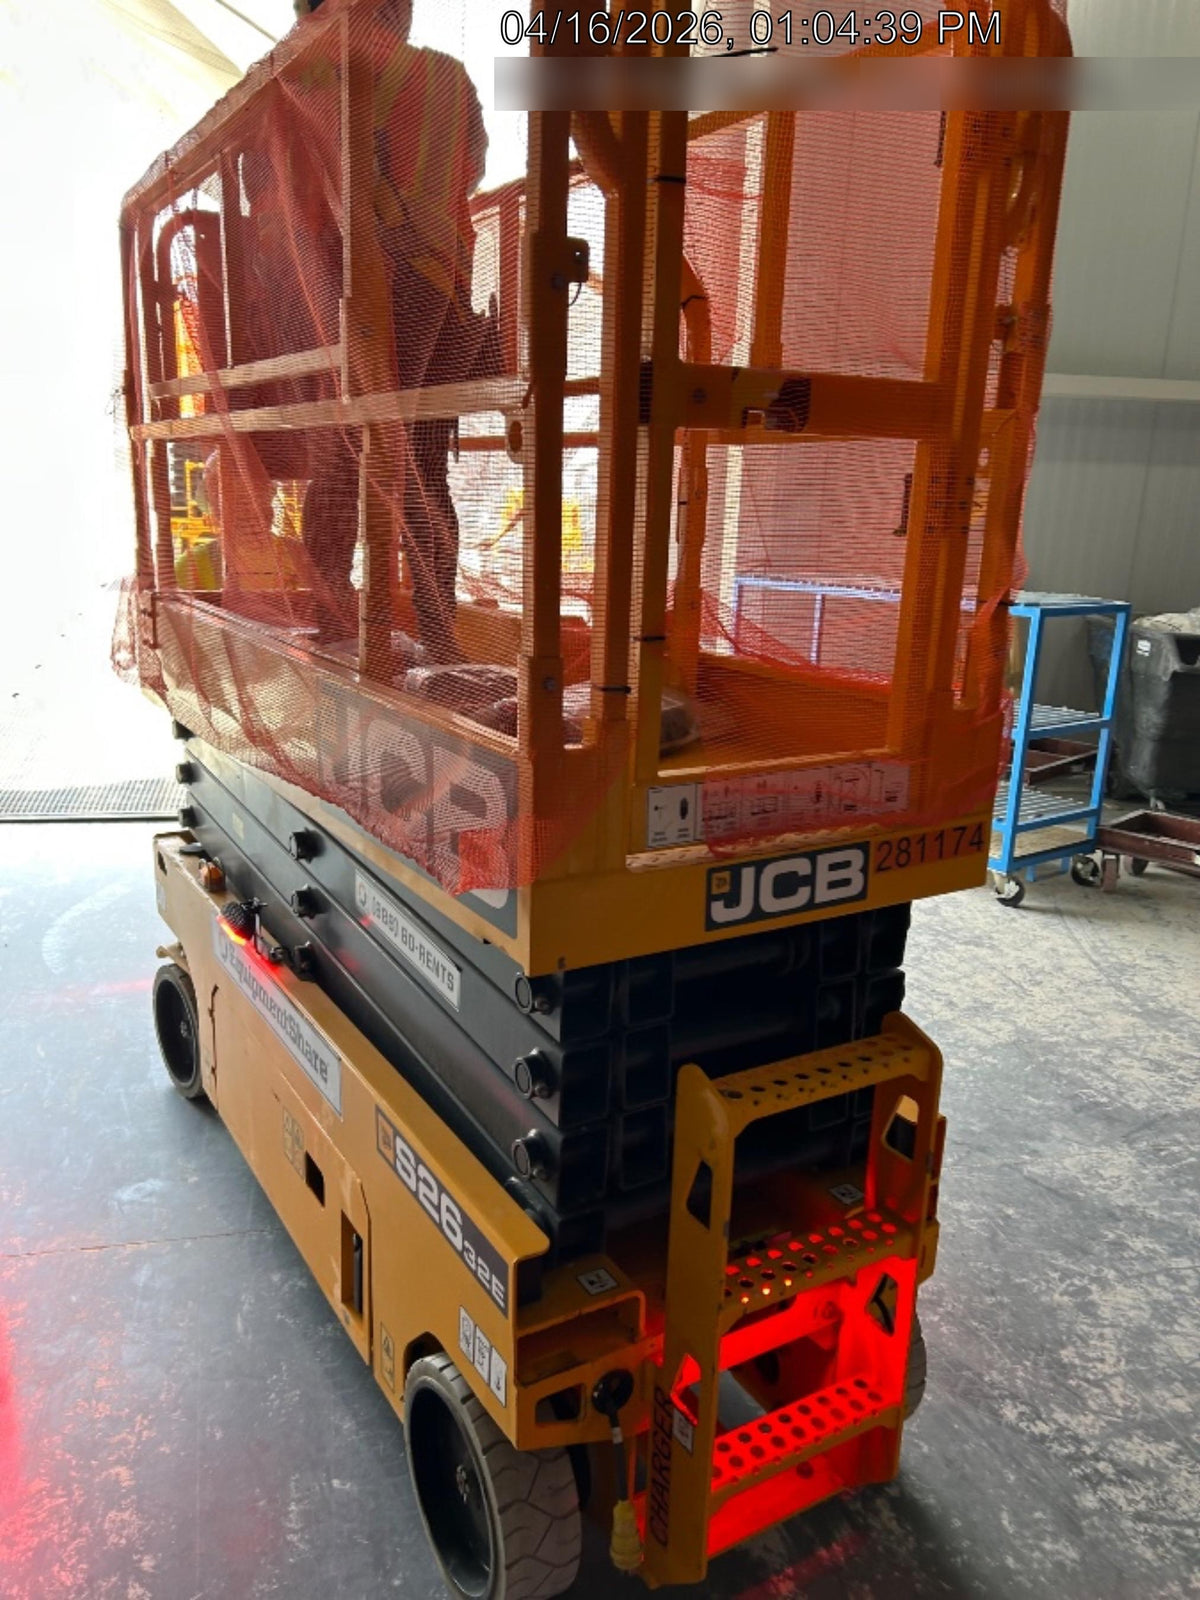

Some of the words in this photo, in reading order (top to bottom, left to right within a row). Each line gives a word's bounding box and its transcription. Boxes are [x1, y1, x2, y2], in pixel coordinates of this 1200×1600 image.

[875, 821, 984, 874] 281174
[709, 848, 865, 924] JCB
[650, 1384, 674, 1547] CHARGER
